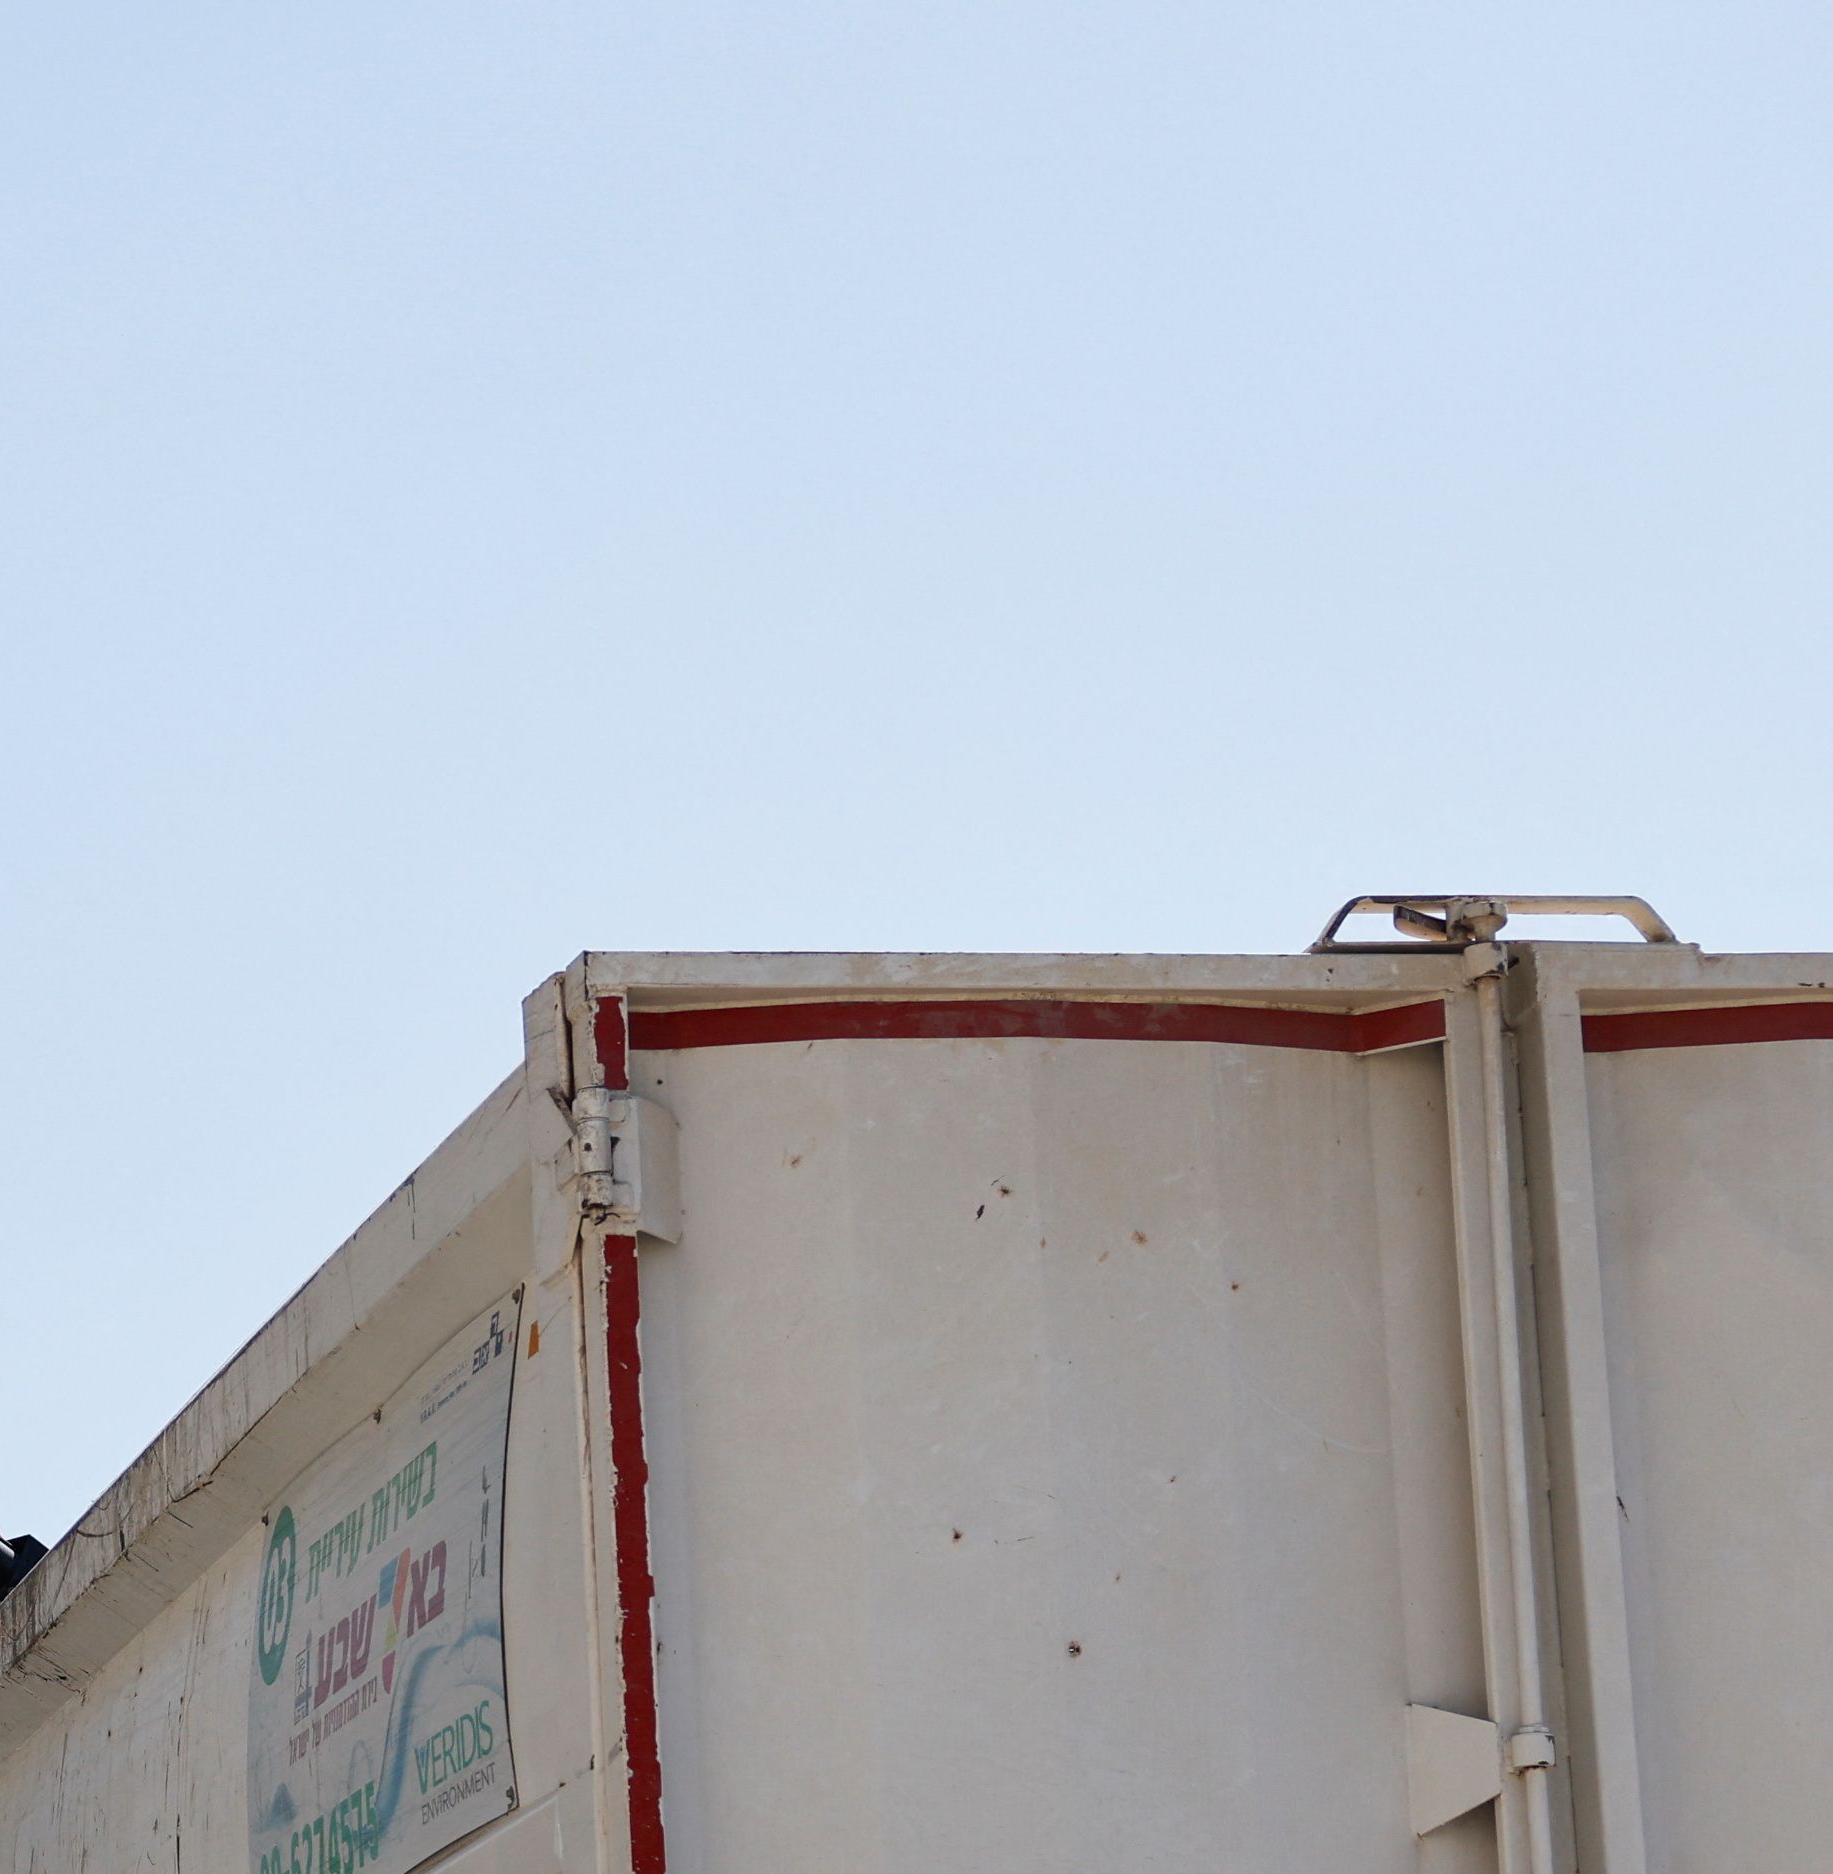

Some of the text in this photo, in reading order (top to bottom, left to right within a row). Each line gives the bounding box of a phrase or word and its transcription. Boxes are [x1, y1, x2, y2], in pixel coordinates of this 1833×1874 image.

[305, 1440, 438, 1604] בשירות עיריית
[313, 1592, 377, 1710] שבע
[414, 1699, 494, 1795] VERIDIS
[421, 1761, 497, 1825] ENVIRONMENT
